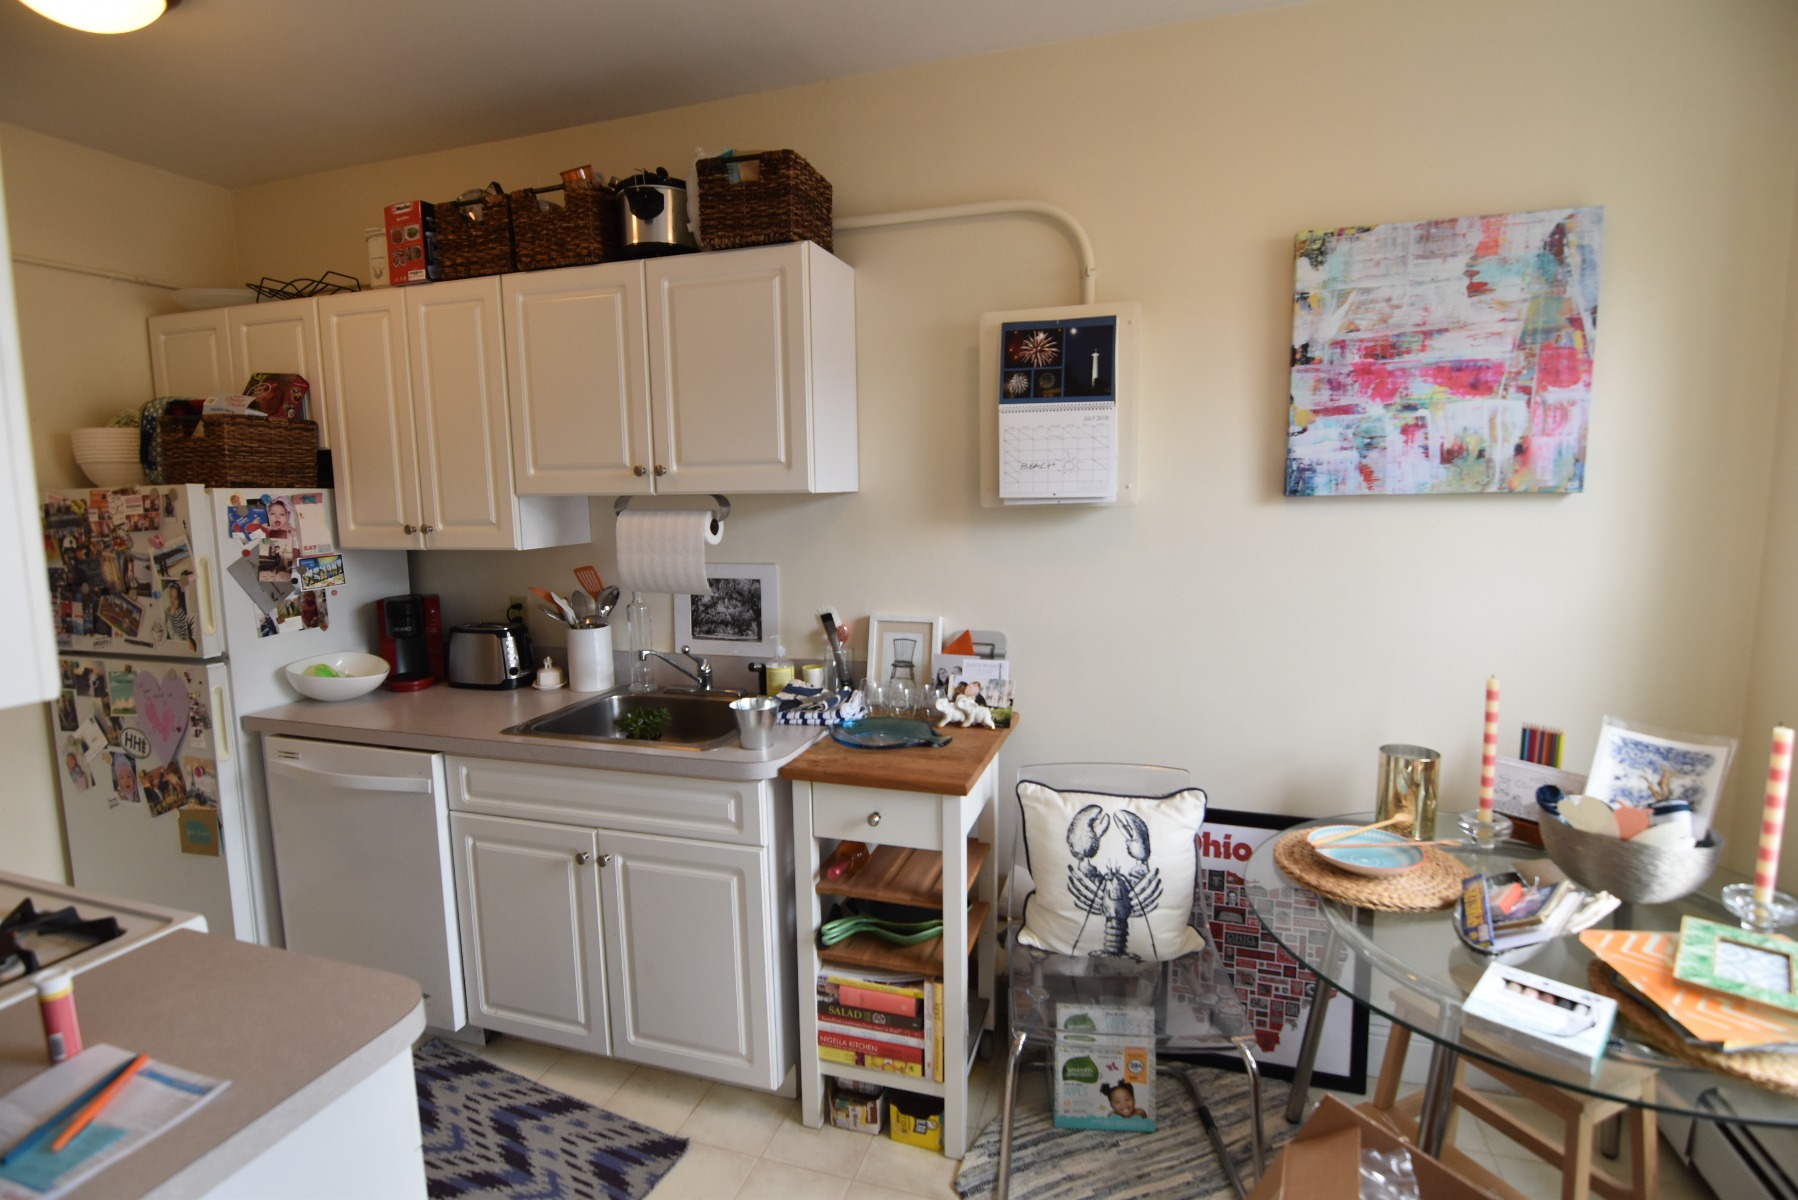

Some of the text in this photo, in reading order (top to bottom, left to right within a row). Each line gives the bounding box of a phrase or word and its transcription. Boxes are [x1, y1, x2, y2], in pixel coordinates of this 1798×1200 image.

[1020, 462, 1056, 471] BEACH
[1197, 831, 1252, 862] hio
[828, 1006, 862, 1019] SALAD
[820, 1035, 847, 1047] NIGELLA
[848, 1041, 878, 1053] KITCHEN
